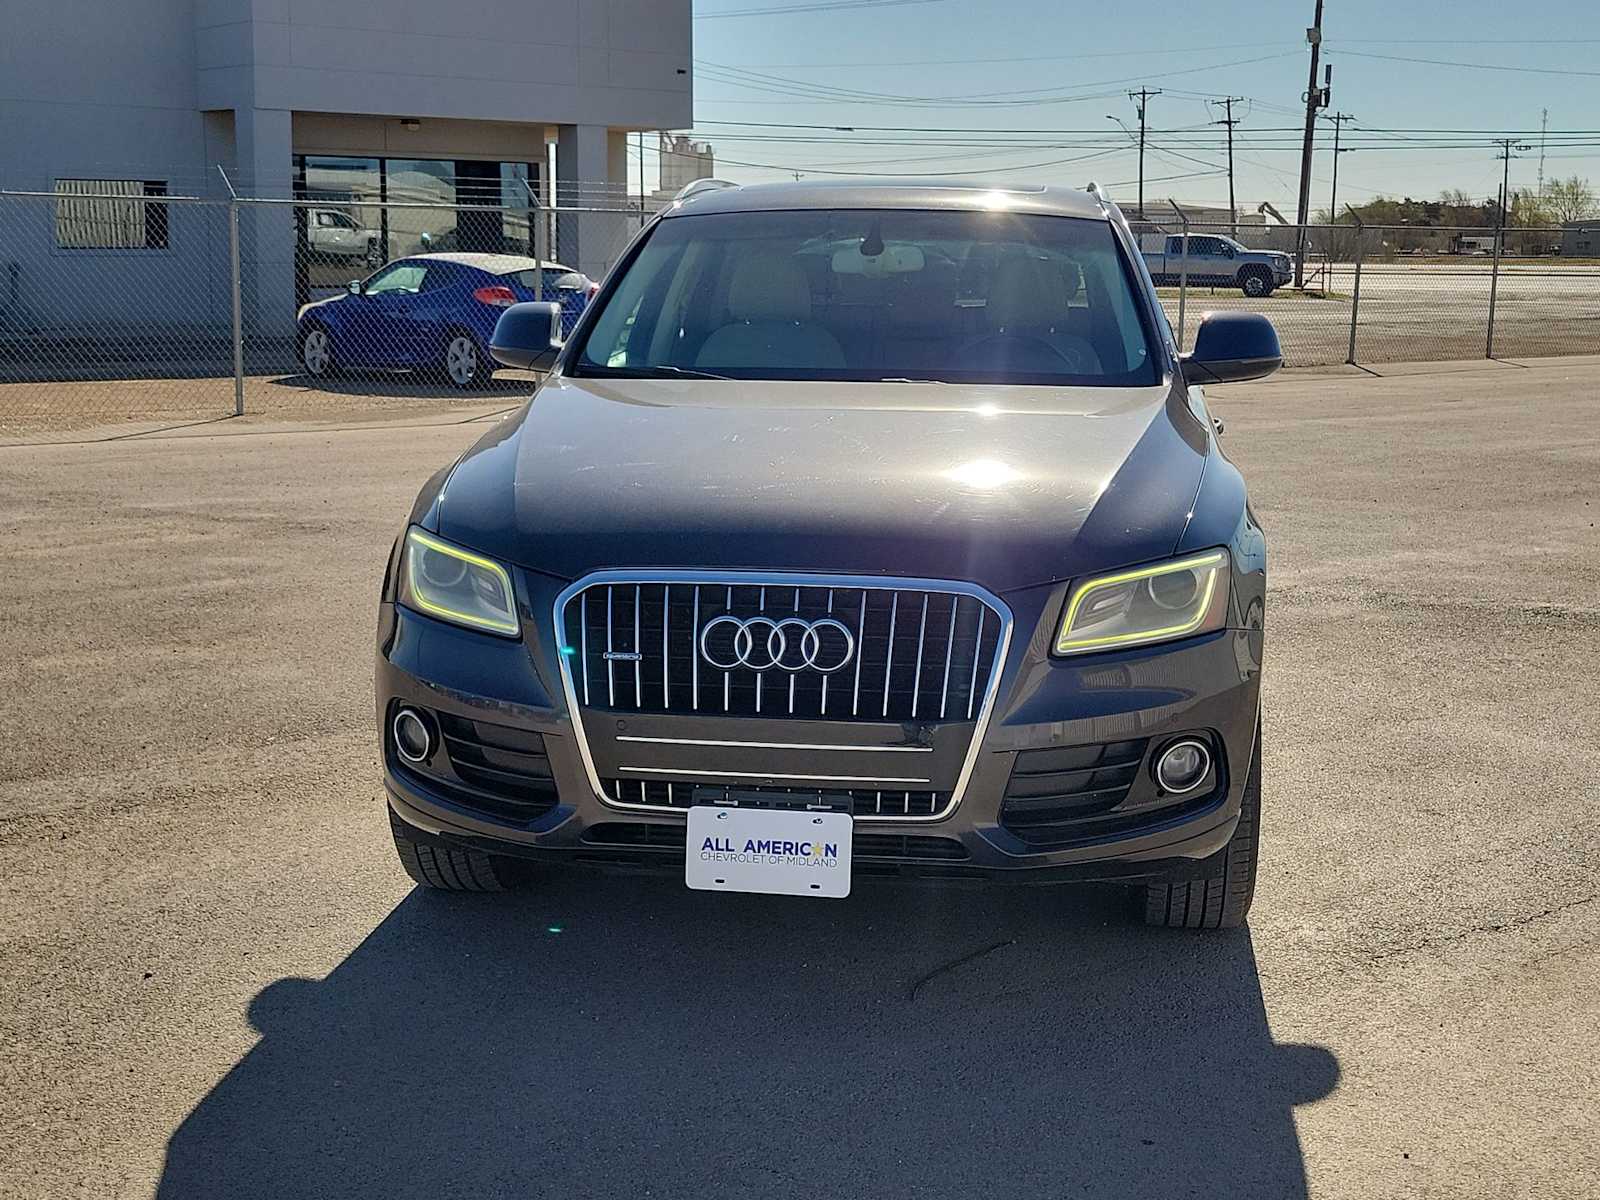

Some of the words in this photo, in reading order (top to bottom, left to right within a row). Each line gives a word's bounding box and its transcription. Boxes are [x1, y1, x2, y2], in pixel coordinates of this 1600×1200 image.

[701, 837, 735, 852] ALL
[700, 852, 767, 864] CHEVROLET
[768, 856, 784, 865] OF
[786, 856, 838, 868] MIDLAND
